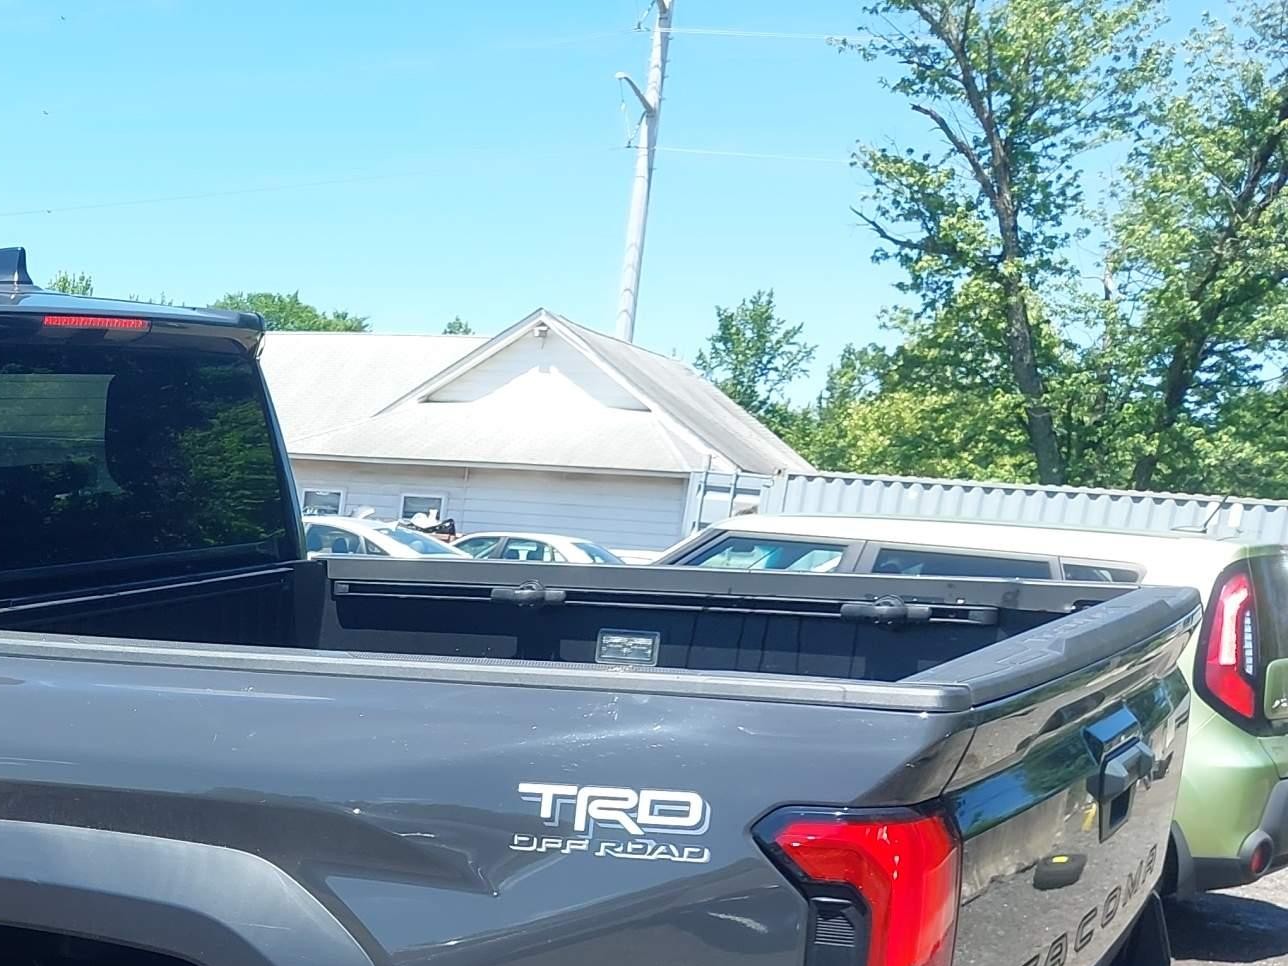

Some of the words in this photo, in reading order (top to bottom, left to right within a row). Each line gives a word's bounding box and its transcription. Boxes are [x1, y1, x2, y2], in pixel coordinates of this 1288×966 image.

[517, 782, 711, 837] TRD
[509, 833, 590, 854] OFF
[594, 838, 711, 864] ROAD
